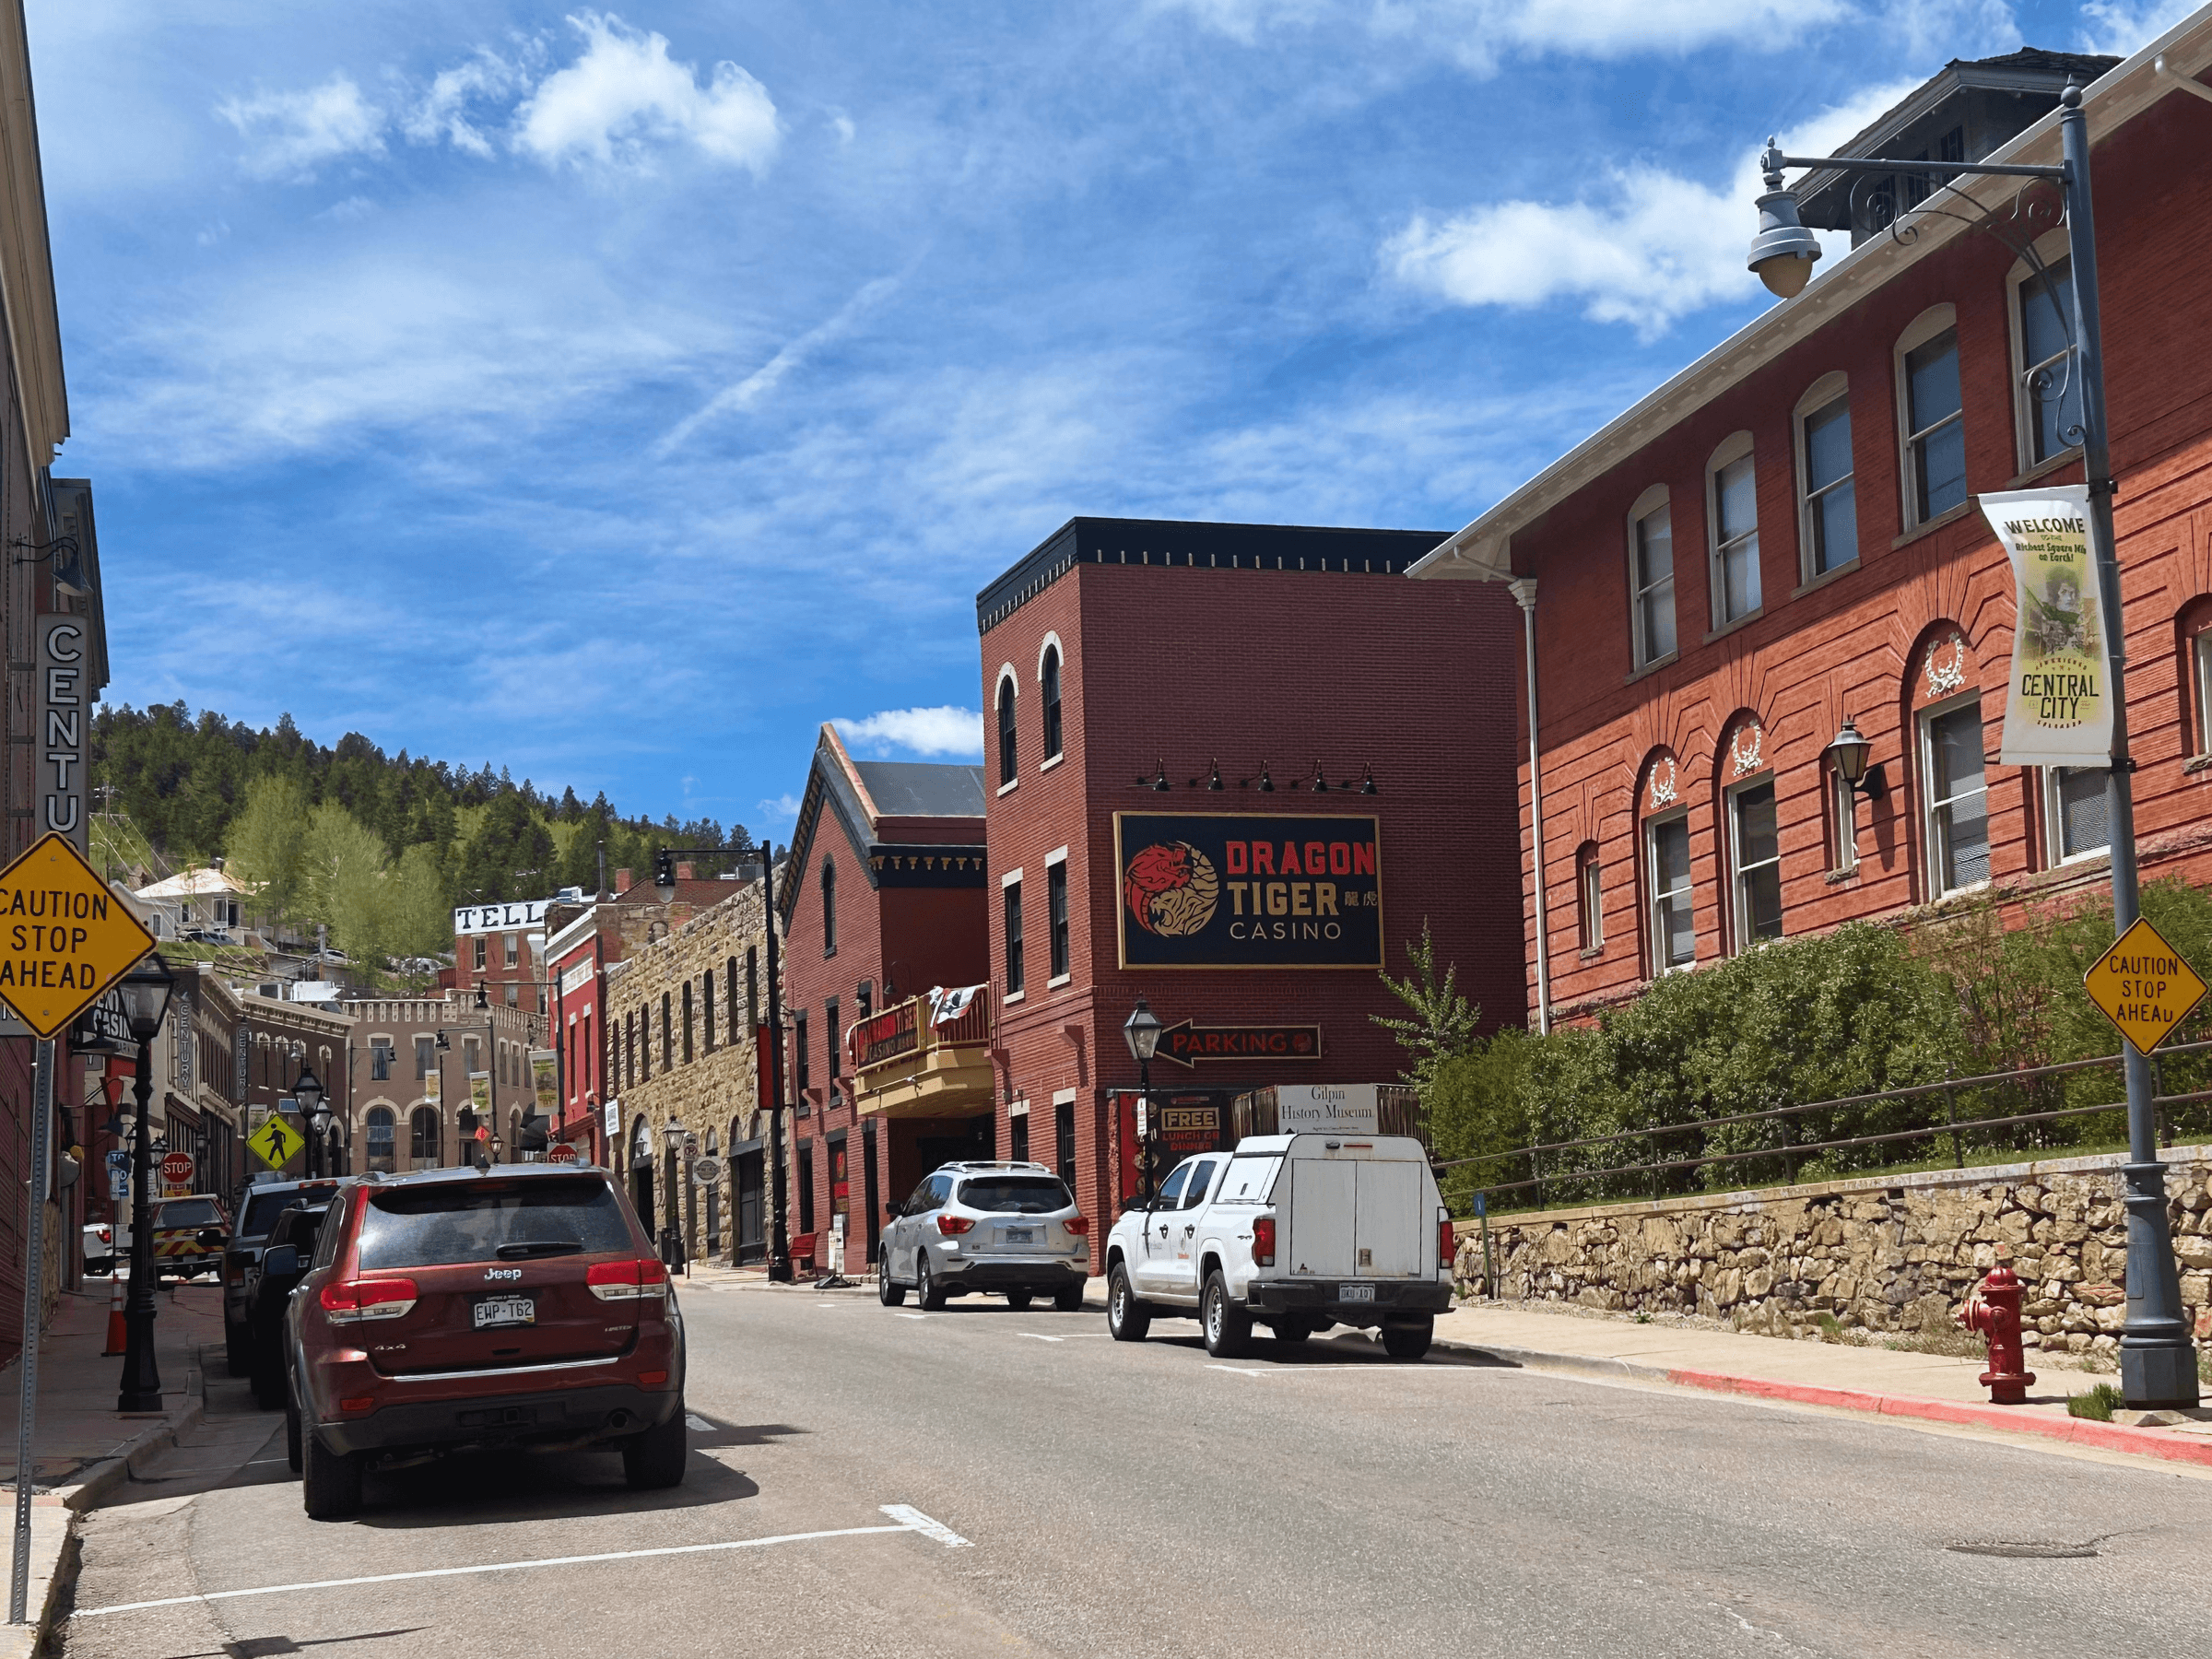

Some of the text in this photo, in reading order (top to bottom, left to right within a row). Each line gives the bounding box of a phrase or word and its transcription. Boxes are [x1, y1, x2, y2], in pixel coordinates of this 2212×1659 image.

[2004, 518, 2085, 534] WELCOME
[2022, 674, 2100, 697] CENTRAL
[2041, 697, 2079, 719] CITY
[47, 624, 82, 832] CENTU
[1226, 841, 1376, 875] DRAGON
[1227, 881, 1339, 915] TIGER
[11, 924, 88, 953] STOP
[1230, 922, 1342, 940] CASINO
[0, 959, 96, 990] AHEAD
[2110, 955, 2178, 976] CAUTION
[2122, 980, 2167, 998] STOP
[2116, 1004, 2173, 1023] AHEAD
[93, 1009, 132, 1040] CASIN
[180, 1005, 190, 1087] CENTURY
[1172, 1033, 1288, 1053] PARKING
[1312, 1086, 1345, 1103] Gilpin
[1167, 1112, 1215, 1126] FREE
[1282, 1104, 1372, 1122] History Museum
[1162, 1131, 1201, 1141] LUNCH
[164, 1161, 192, 1173] STOP
[484, 1268, 522, 1280] Jeep
